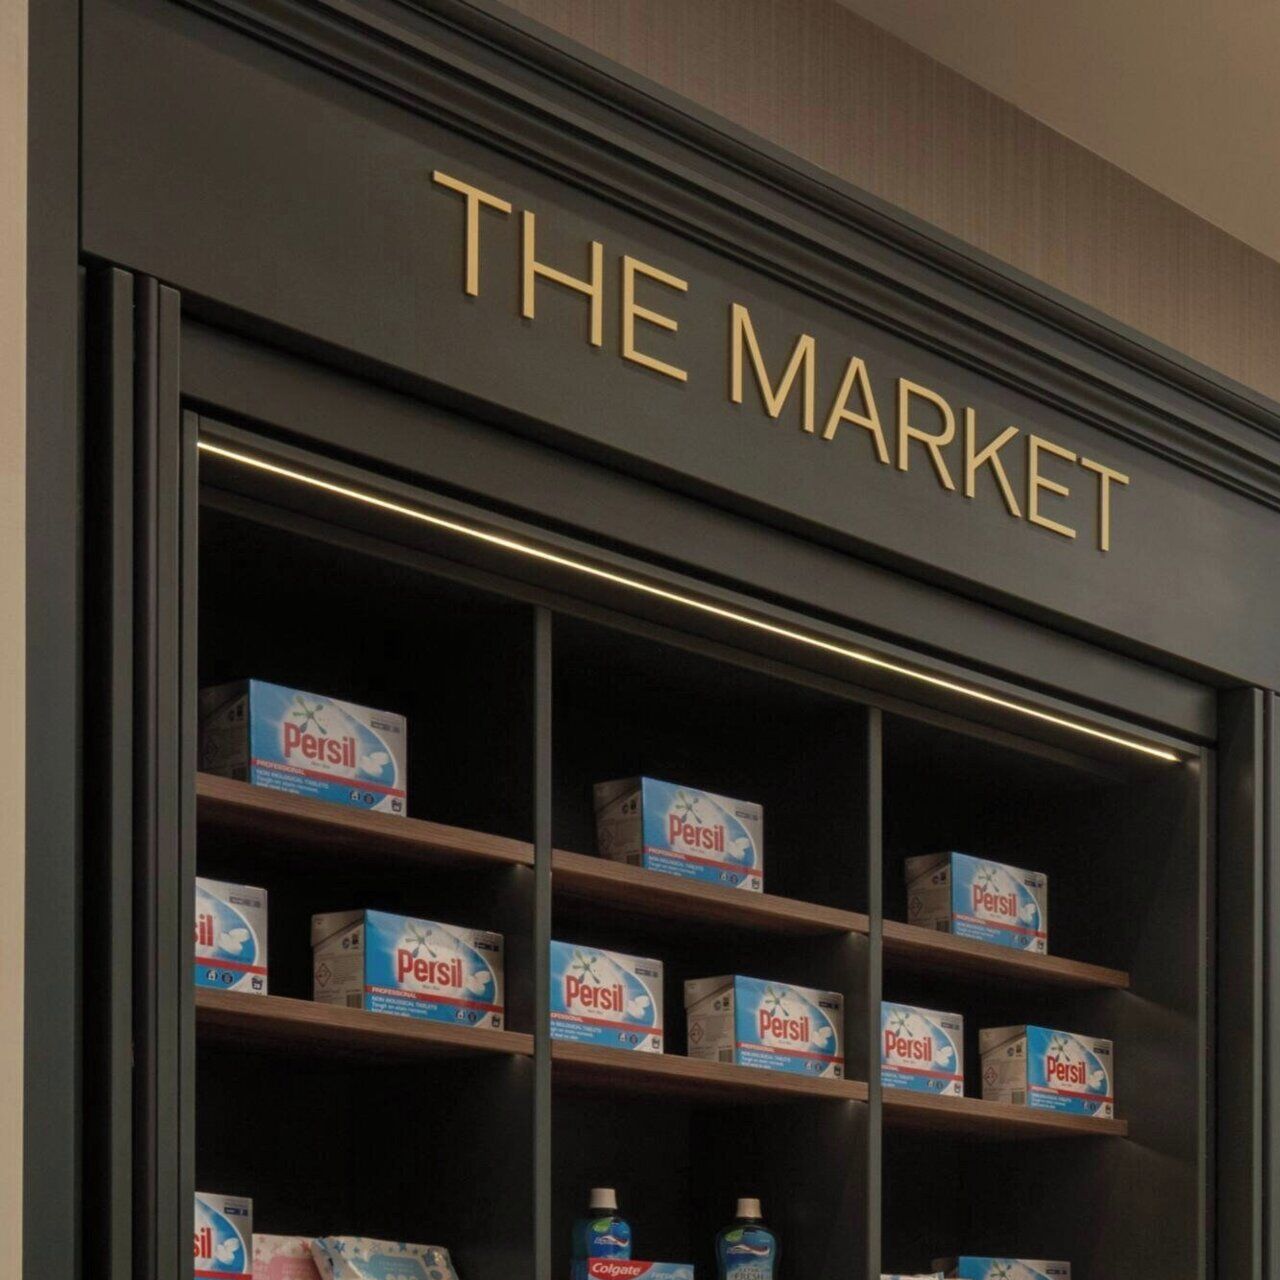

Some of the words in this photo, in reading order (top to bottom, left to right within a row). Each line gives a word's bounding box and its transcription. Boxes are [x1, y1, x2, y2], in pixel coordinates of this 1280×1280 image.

[433, 169, 688, 382] THE
[731, 301, 1130, 552] MARKET
[283, 722, 356, 768] Persil
[669, 814, 724, 852] Persil
[973, 884, 1017, 918] Persil
[397, 949, 463, 989] Persil
[566, 975, 624, 1013] Persil
[759, 1009, 810, 1042] Persil
[885, 1029, 932, 1062] Persil
[1047, 1055, 1086, 1084] Persil
[591, 1262, 641, 1277] Colgate
